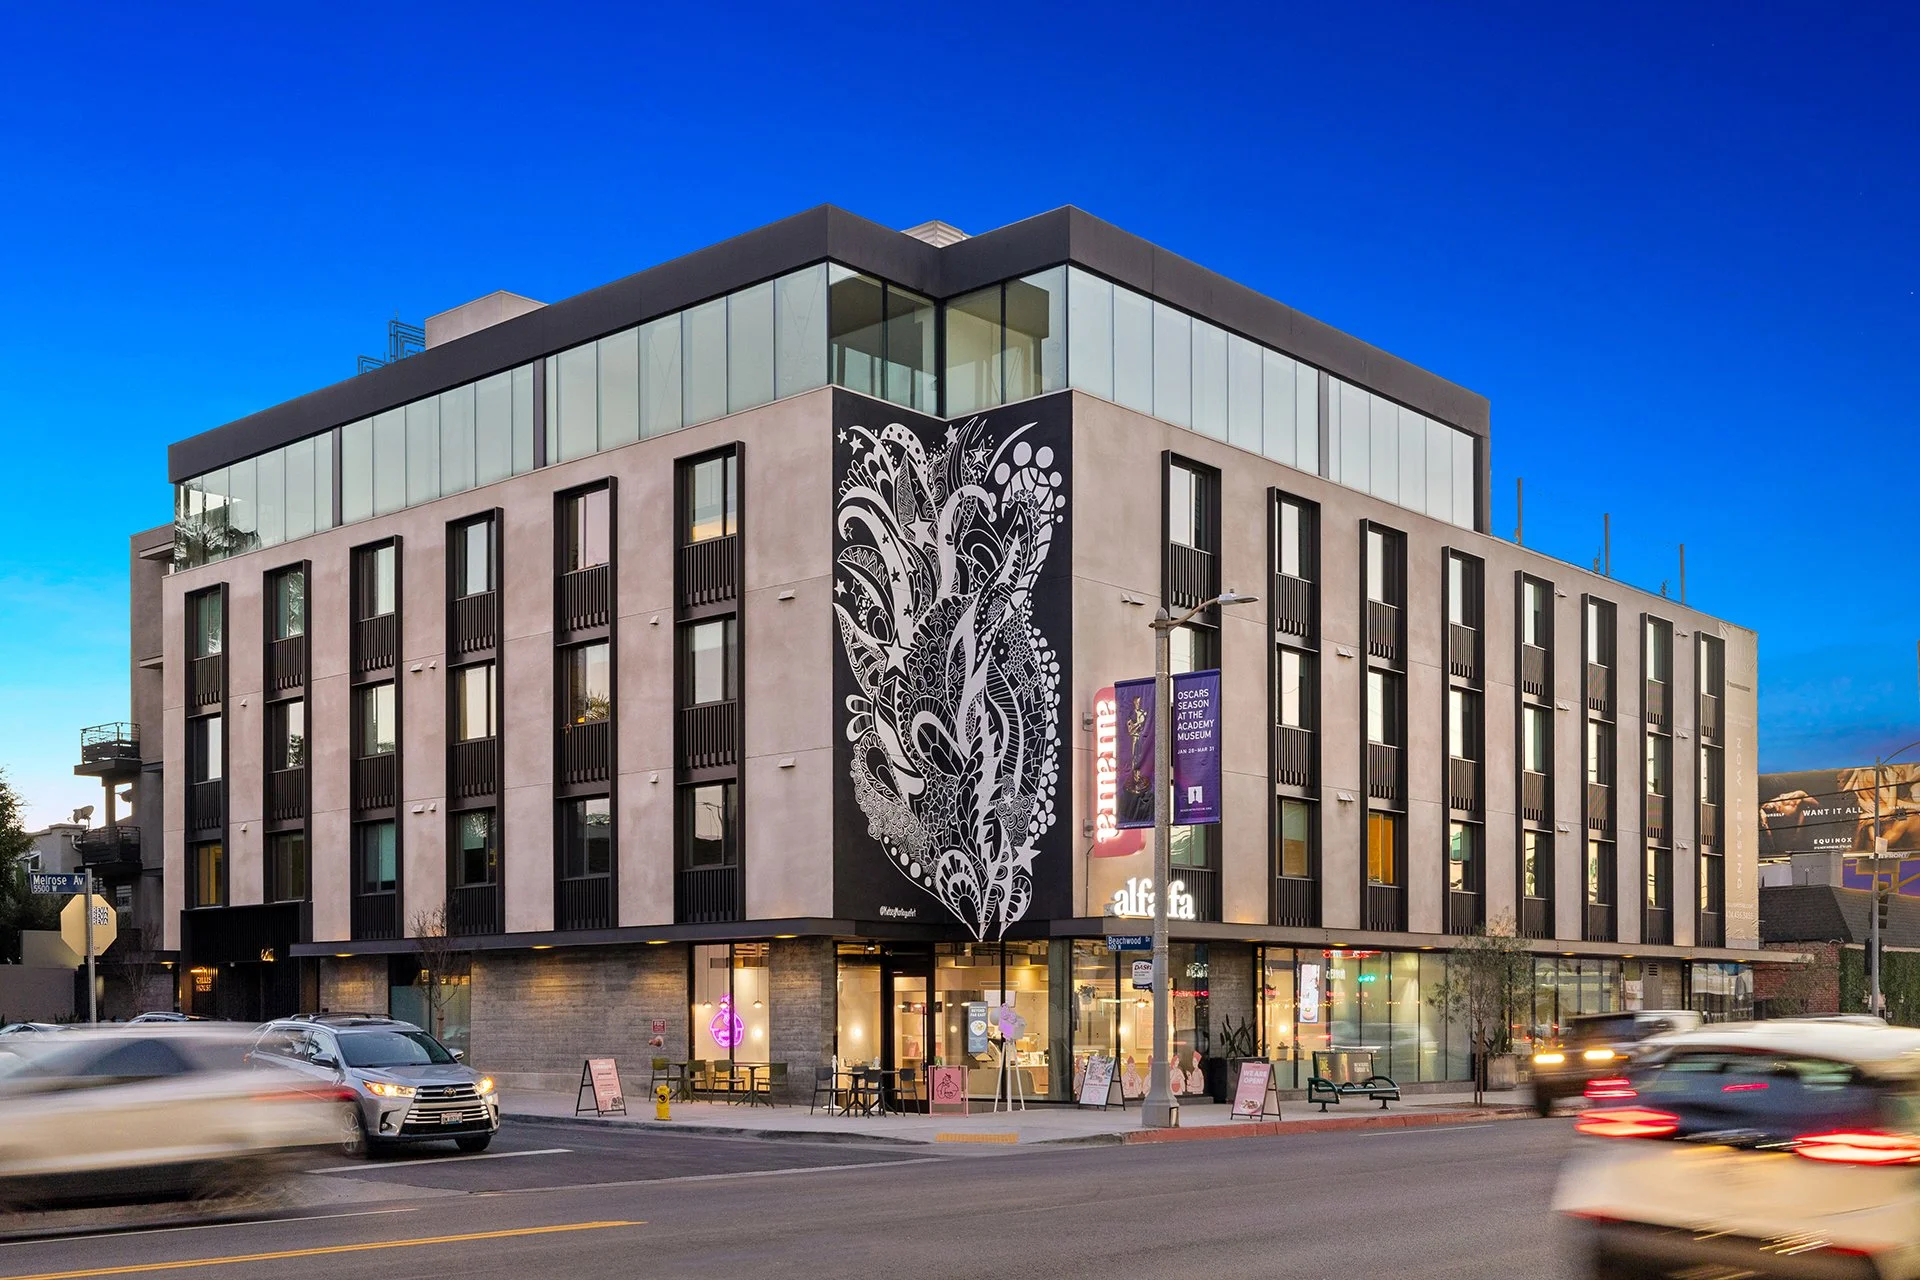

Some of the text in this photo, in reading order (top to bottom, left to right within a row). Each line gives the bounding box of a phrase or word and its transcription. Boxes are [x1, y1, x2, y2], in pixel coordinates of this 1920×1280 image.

[1178, 689, 1209, 700] OSCARS
[1178, 699, 1209, 710] SEASON
[1177, 710, 1203, 720] AT THE
[1177, 719, 1215, 731] ACADEMY
[1177, 730, 1211, 741] MUSEUM
[1803, 808, 1829, 817] WANT
[1813, 837, 1852, 845] EQUINOX
[33, 874, 84, 885] Melrose Av
[1114, 877, 1195, 919] alffa
[1108, 936, 1141, 945] Beachwood
